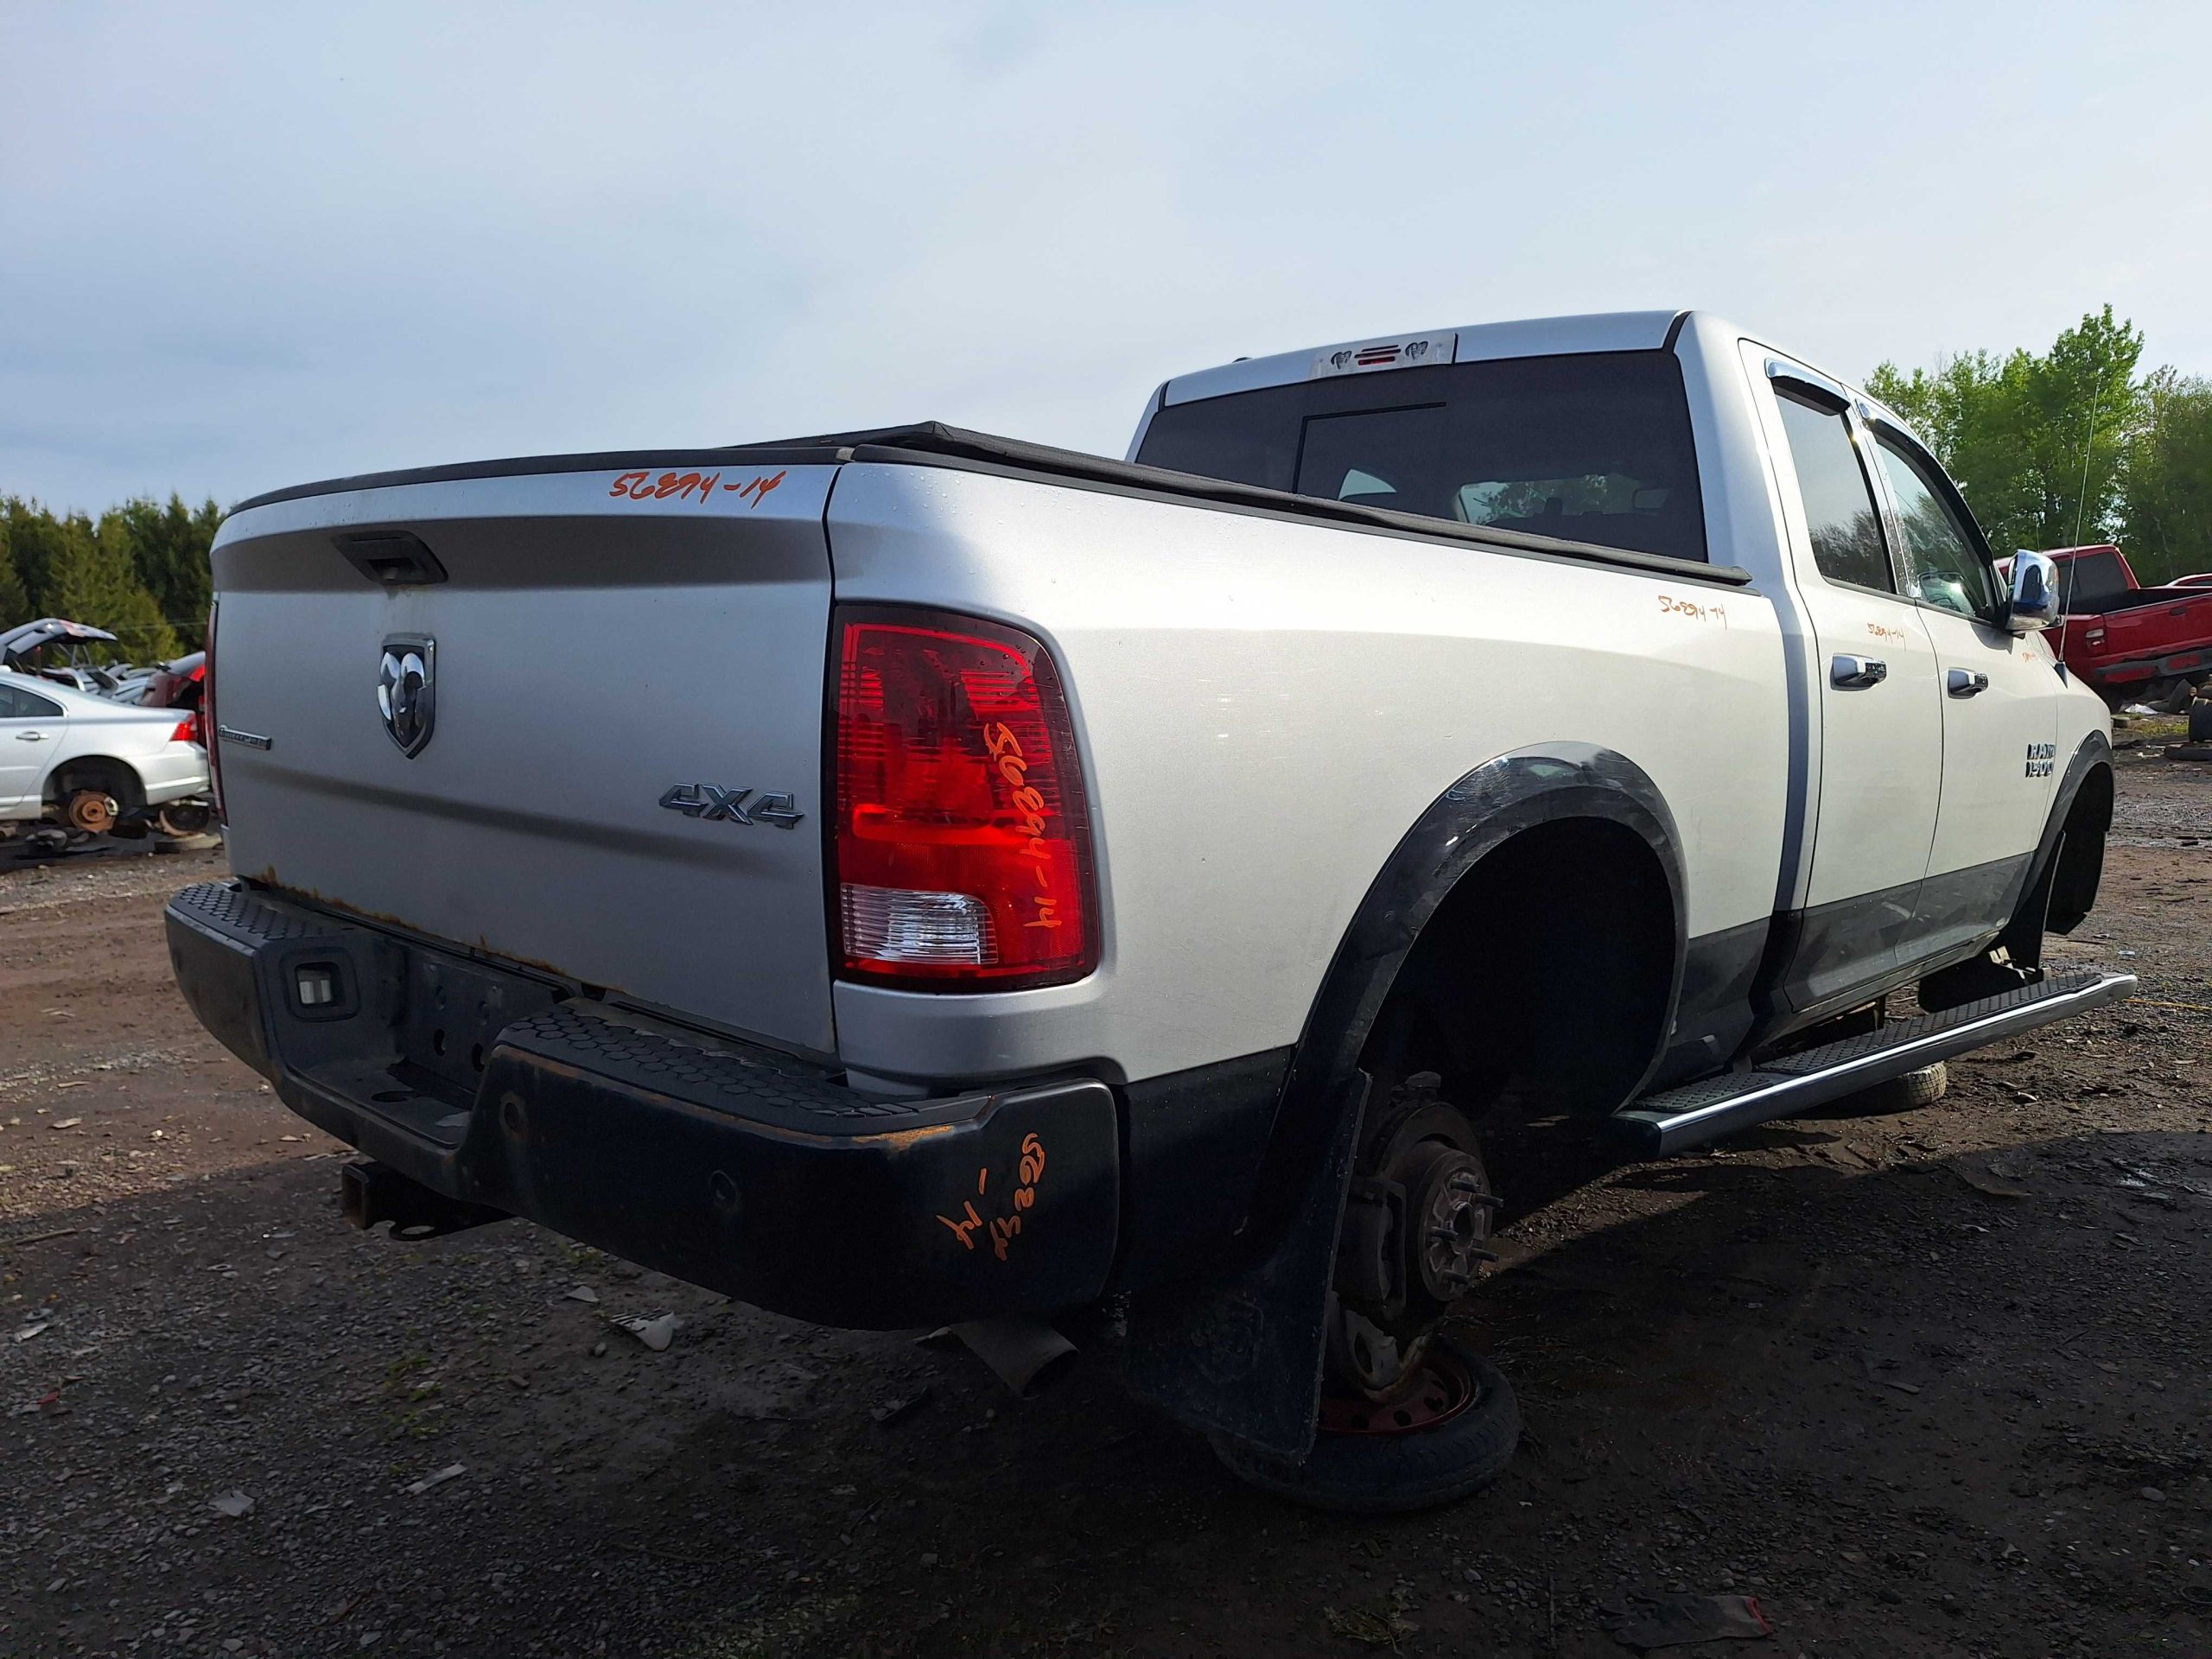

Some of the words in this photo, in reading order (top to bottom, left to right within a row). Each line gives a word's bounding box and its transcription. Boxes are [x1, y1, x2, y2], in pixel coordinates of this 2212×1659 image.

[608, 470, 787, 510] 56894-14
[2026, 743, 2056, 760] RAM
[2024, 761, 2055, 778] 1500
[983, 721, 1063, 928] 56894-14
